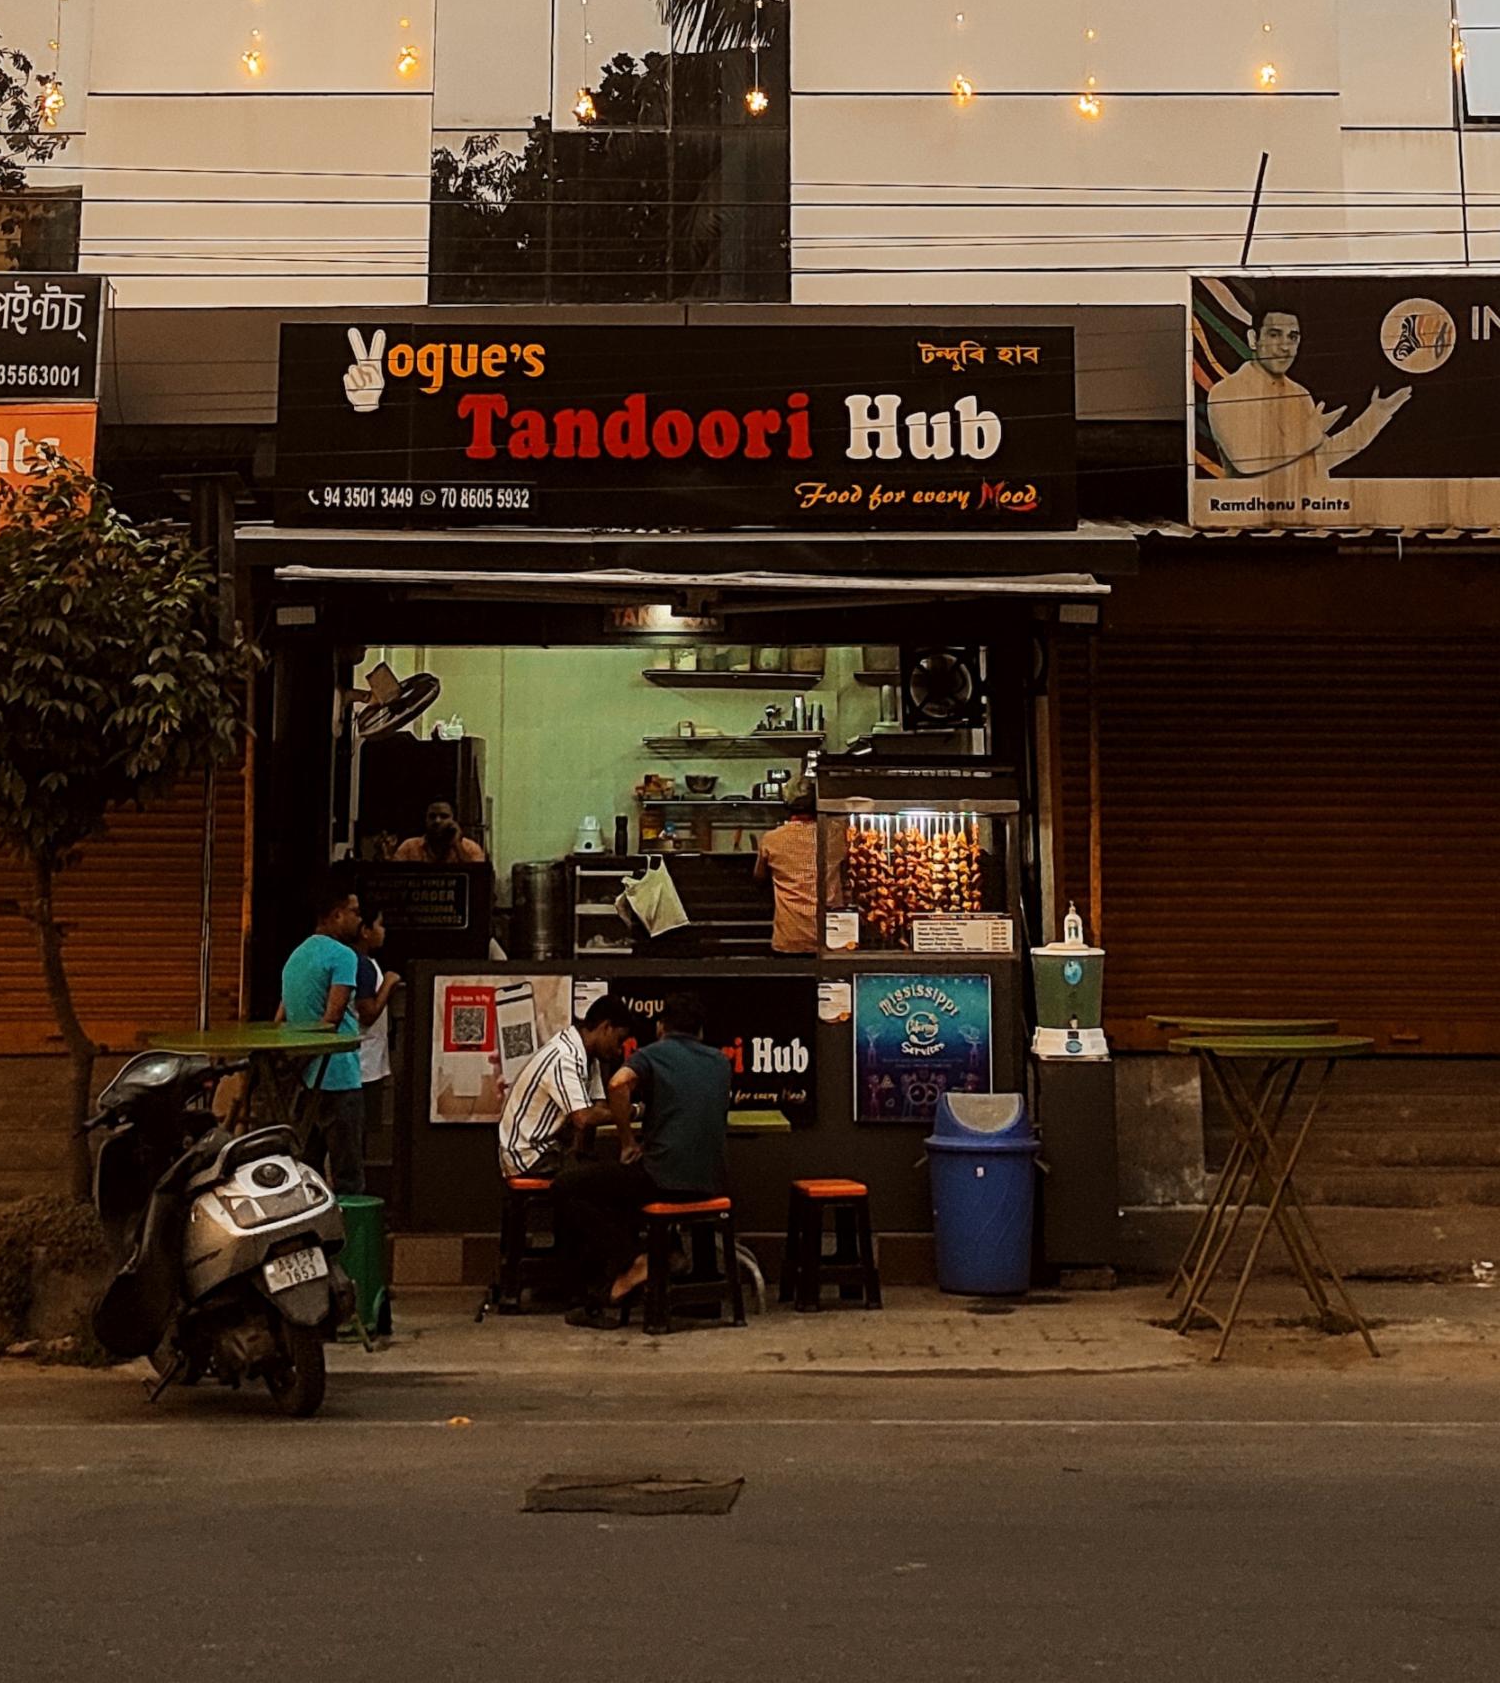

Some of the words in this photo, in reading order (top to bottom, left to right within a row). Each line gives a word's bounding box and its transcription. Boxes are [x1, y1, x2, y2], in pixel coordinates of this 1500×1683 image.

[457, 392, 814, 462] Tandoori
[843, 392, 1004, 462] Hub
[323, 487, 341, 509] 94
[343, 487, 378, 508] 3501
[380, 487, 414, 508] 3449
[440, 488, 458, 509] 70
[460, 488, 495, 509] 8605
[496, 488, 531, 509] 5932
[794, 482, 863, 509] Food
[868, 484, 906, 510] for
[912, 489, 971, 510] every
[977, 477, 1039, 511] Mood
[1209, 496, 1296, 512] Ramdhenu
[1301, 497, 1350, 512] Paints
[751, 1037, 809, 1074] Hub
